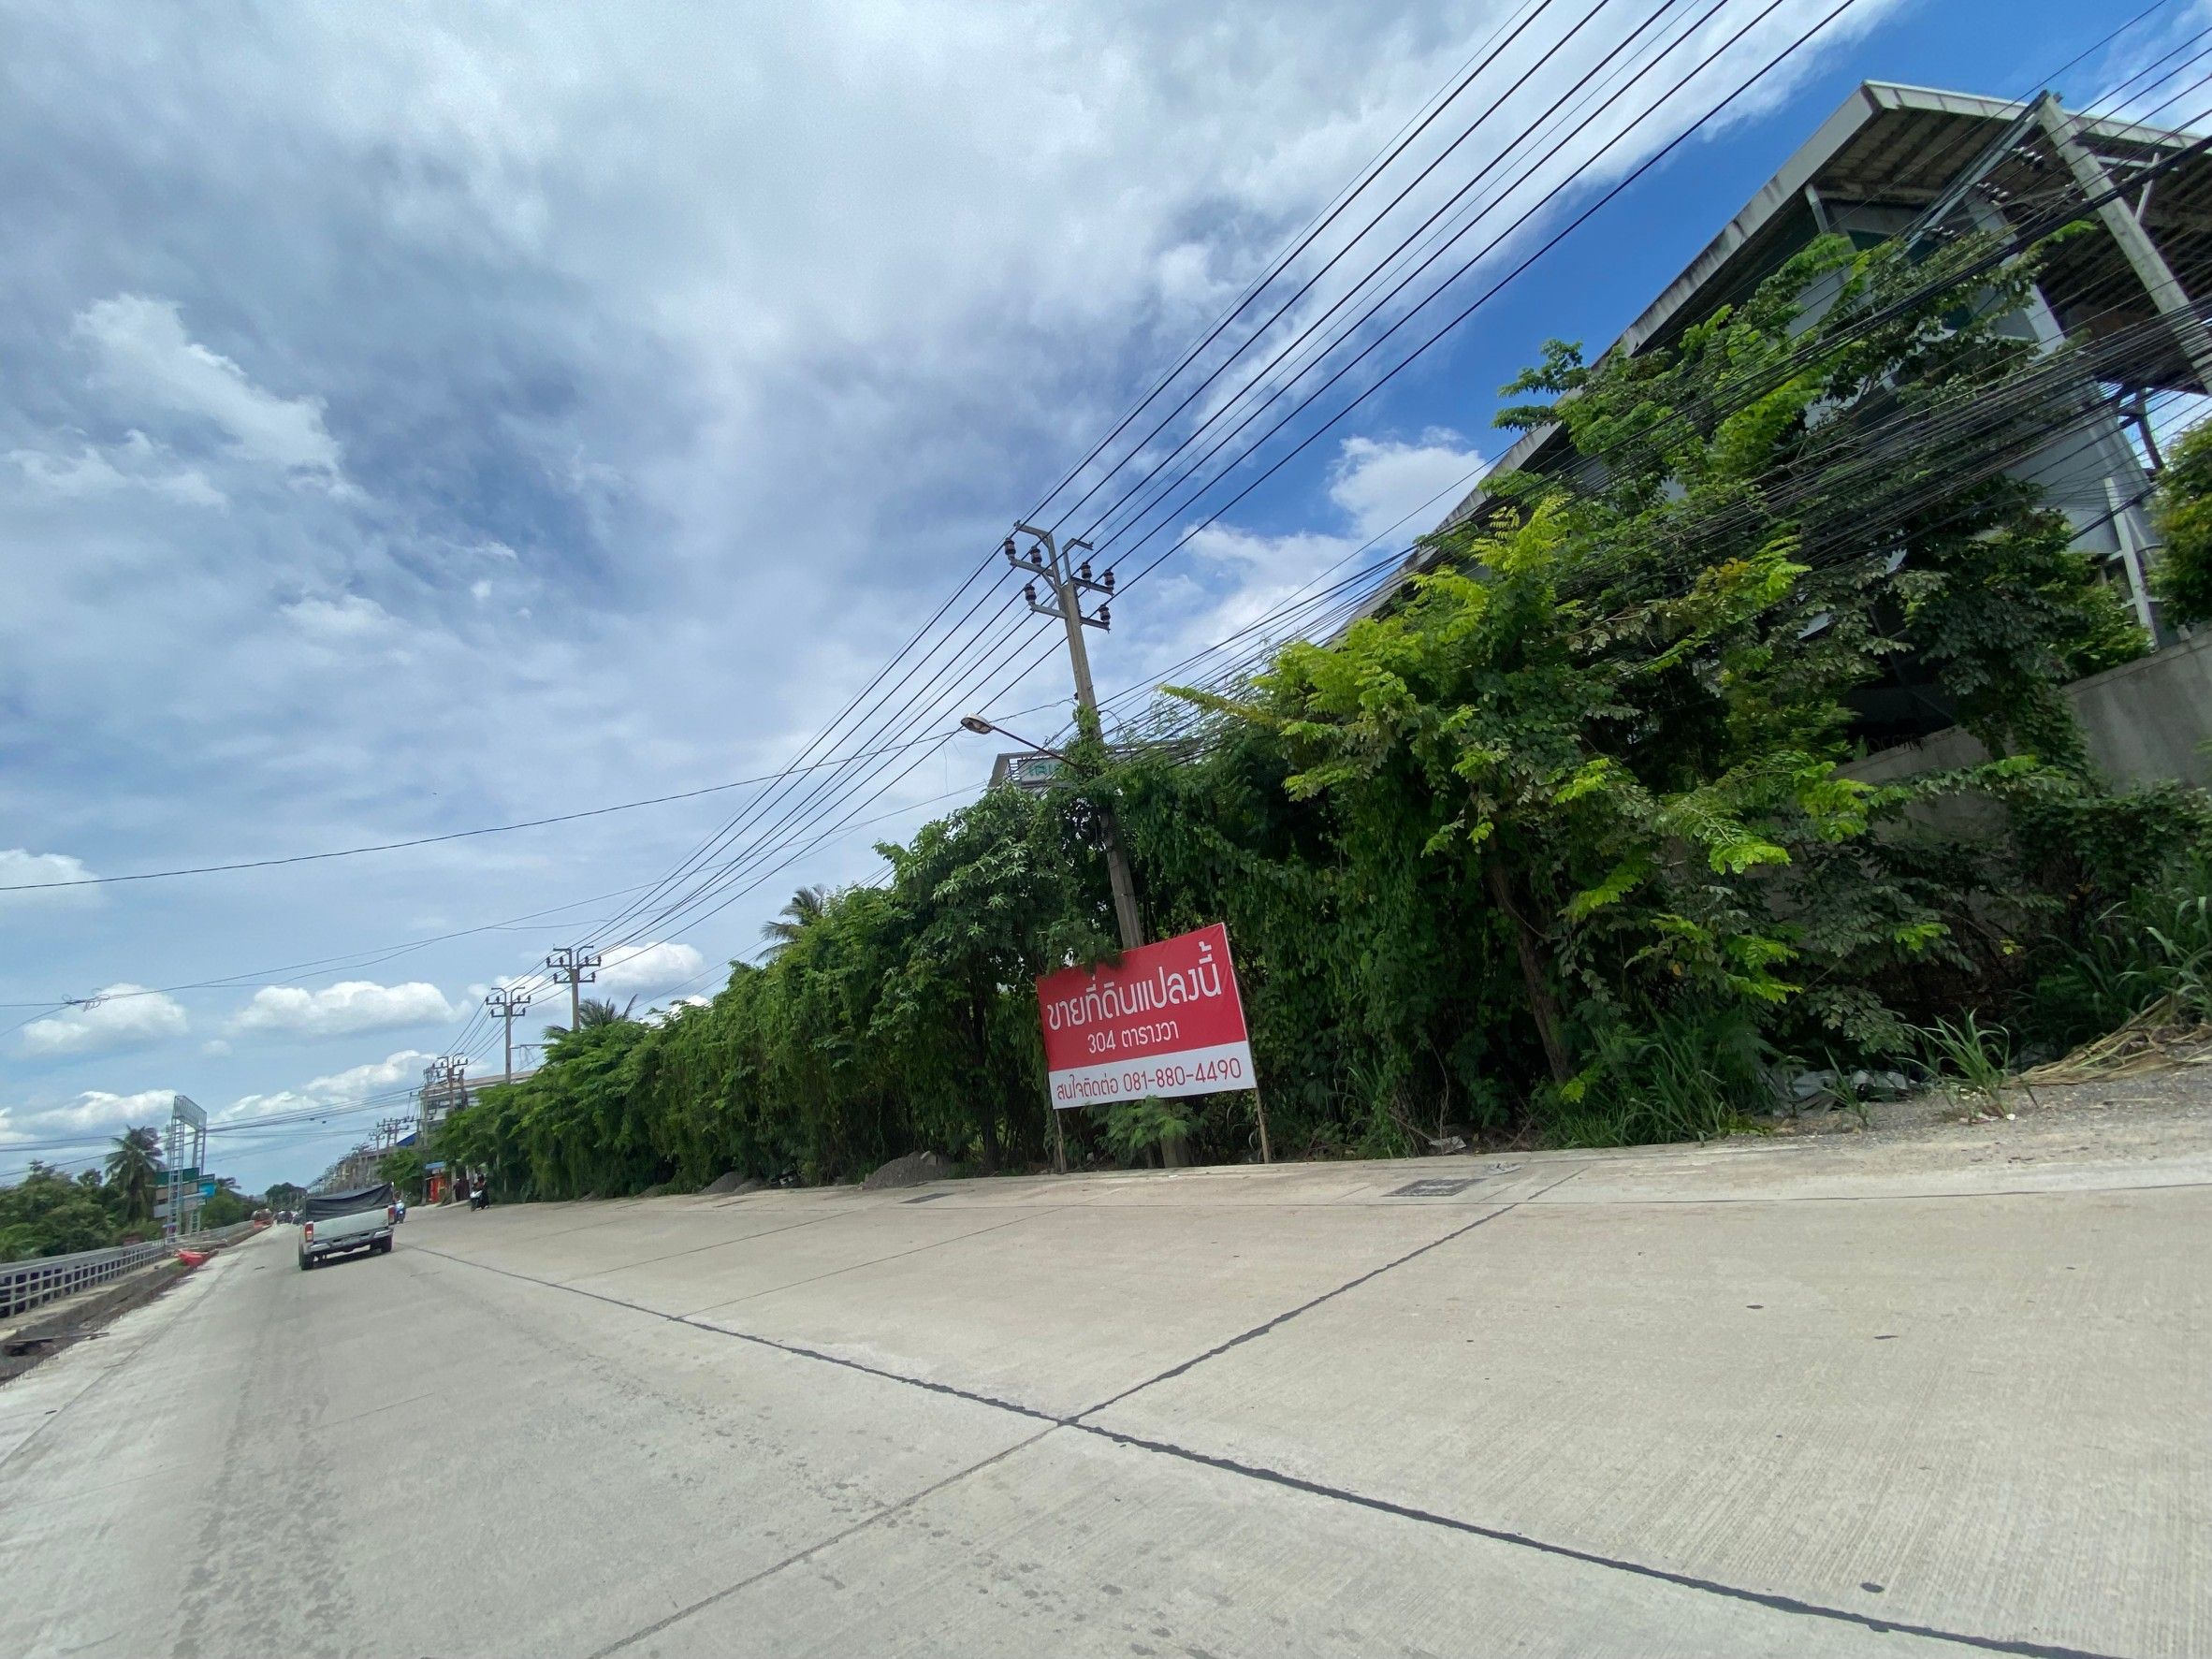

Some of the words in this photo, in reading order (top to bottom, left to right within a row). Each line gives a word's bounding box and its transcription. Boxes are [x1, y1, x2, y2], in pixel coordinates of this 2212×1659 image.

[1047, 940, 1222, 1030] ขายที่ดินแปลงนี้
[1087, 1029, 1116, 1054] 304
[1121, 1020, 1179, 1048] ตารางวา
[1056, 1072, 1119, 1100] สนใจติดต่อ
[1123, 1057, 1242, 1092] 081-880-4490
